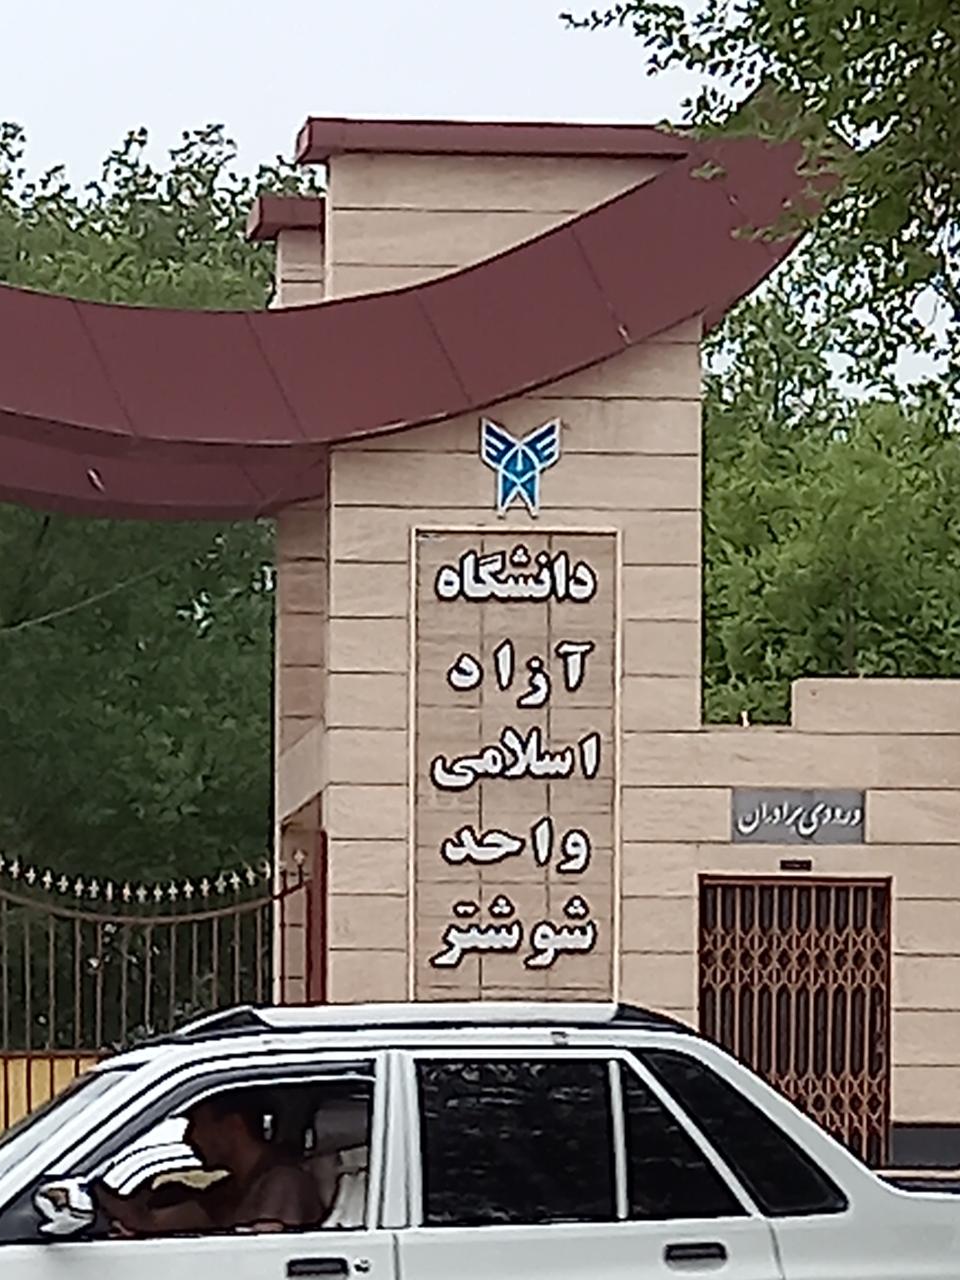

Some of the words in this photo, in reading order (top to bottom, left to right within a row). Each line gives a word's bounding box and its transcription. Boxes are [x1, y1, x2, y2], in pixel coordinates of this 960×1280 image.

[437, 545, 596, 601] دانشگاه
[448, 640, 595, 706] آزاد
[432, 727, 600, 790] اسلامی
[442, 817, 591, 873] واحد
[738, 801, 804, 834] برادران
[798, 802, 861, 836] ورودی
[431, 896, 596, 967] شوشتر
